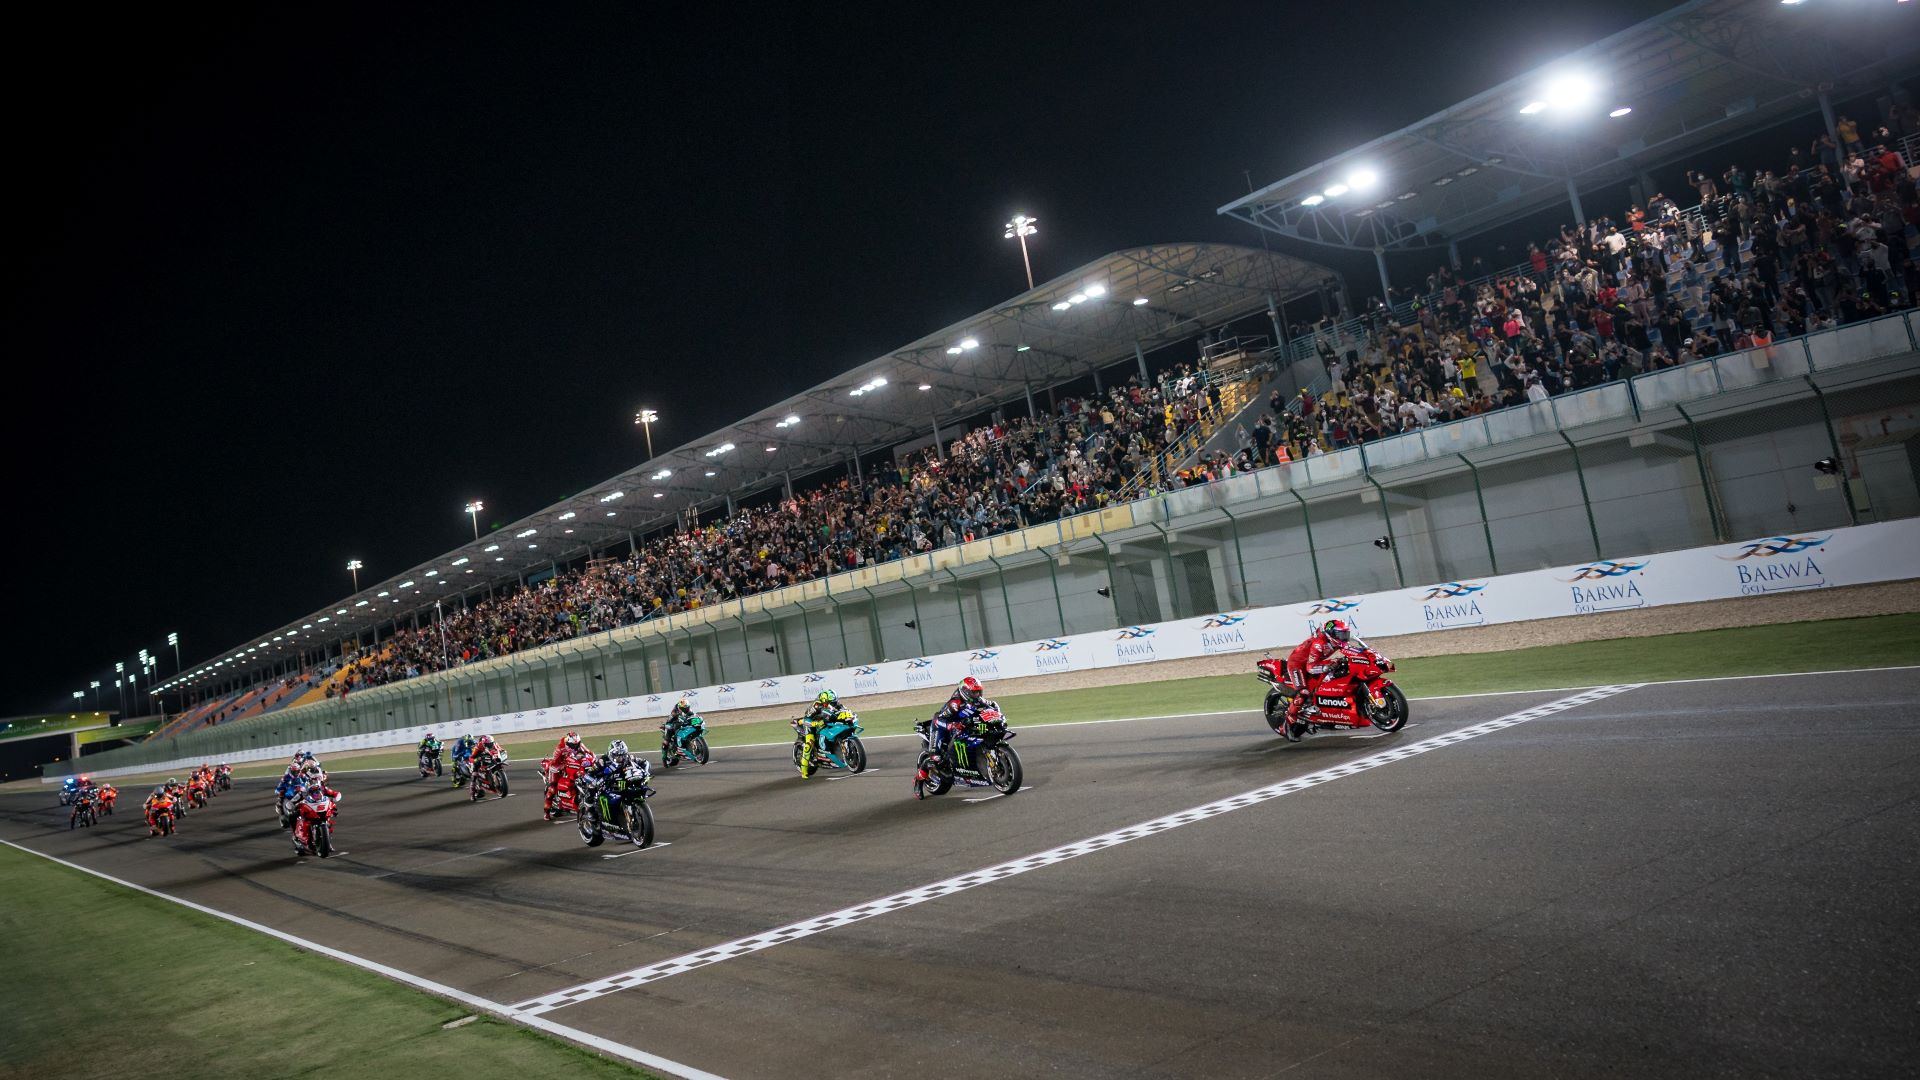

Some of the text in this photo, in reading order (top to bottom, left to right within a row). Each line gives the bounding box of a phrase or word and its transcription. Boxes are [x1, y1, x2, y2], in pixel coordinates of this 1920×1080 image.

[1737, 556, 1824, 584] BARWA
[1571, 579, 1642, 604] BARWA
[1423, 599, 1482, 621] BARWA
[1202, 628, 1244, 647] BARWA
[1116, 640, 1154, 657] BARWA
[1318, 696, 1349, 707] Lenovo
